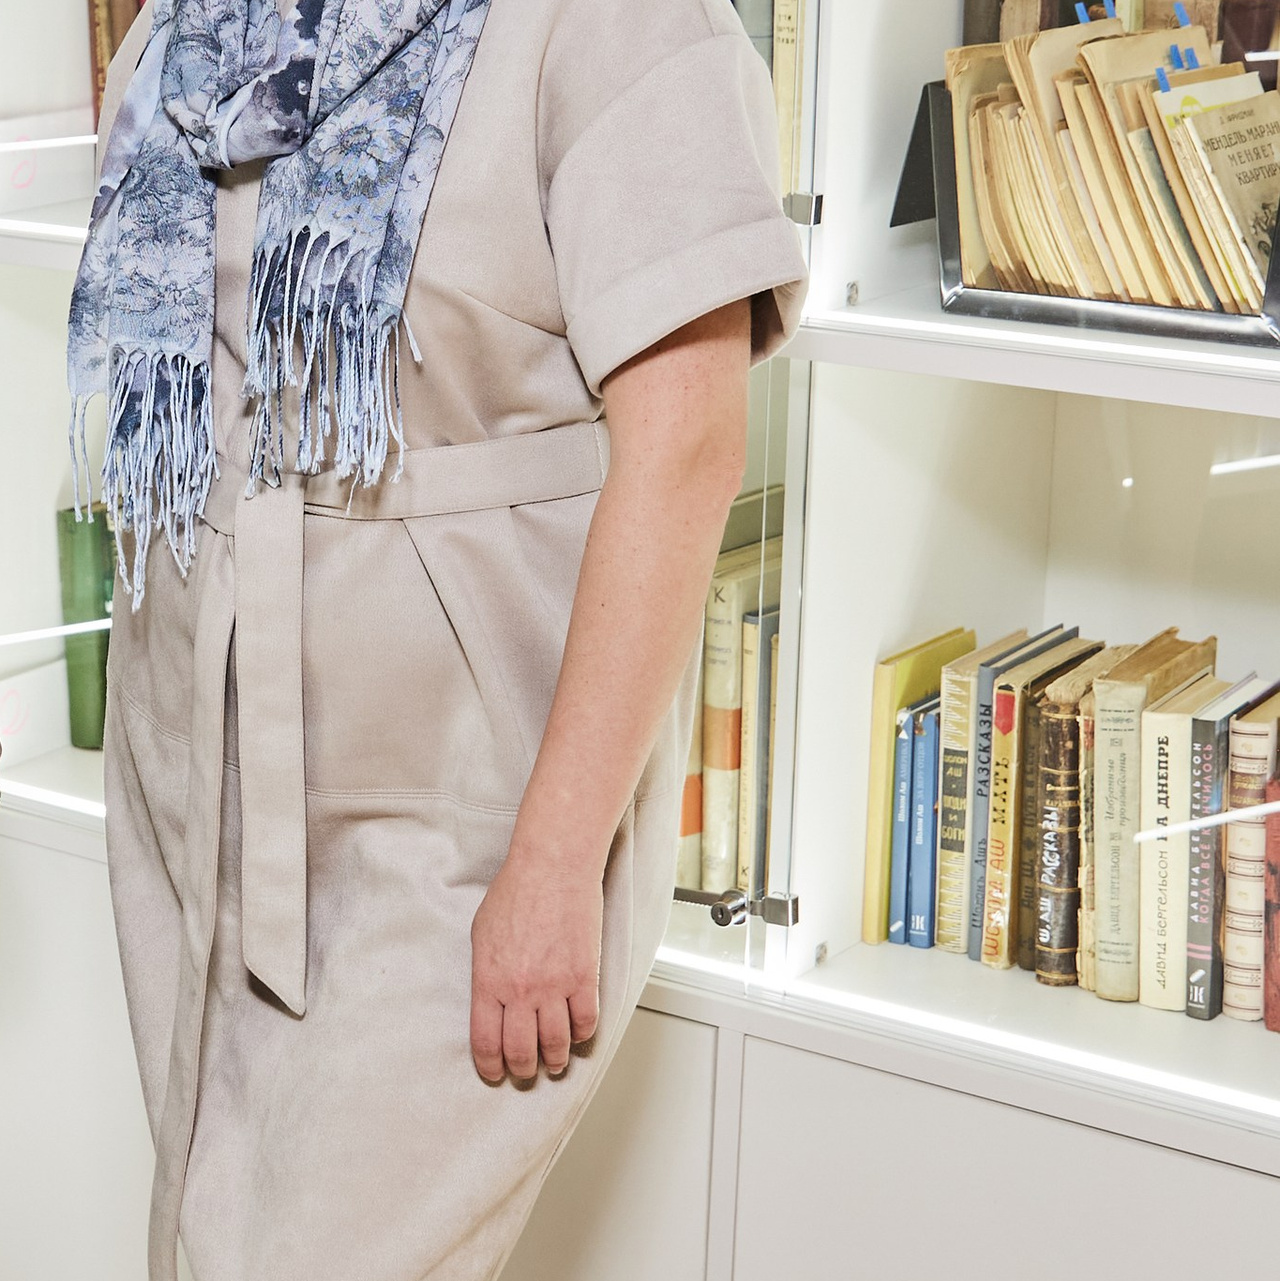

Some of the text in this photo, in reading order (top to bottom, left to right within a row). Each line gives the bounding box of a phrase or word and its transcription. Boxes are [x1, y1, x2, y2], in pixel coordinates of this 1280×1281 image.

[1204, 120, 1280, 152] МЕНДЕЛЬ МАРАН
[1228, 143, 1274, 167] МЕНЯЕТ
[947, 767, 962, 776] АШ
[977, 704, 993, 798] РАЗСКАЗЫ
[1157, 735, 1170, 809] ДНЕПРЕ
[1202, 744, 1213, 836] КНЧИЛОСЬ
[1190, 742, 1202, 922] ДАВИД БЕГЕЛЬСОН
[1199, 878, 1210, 923] КОГДА
